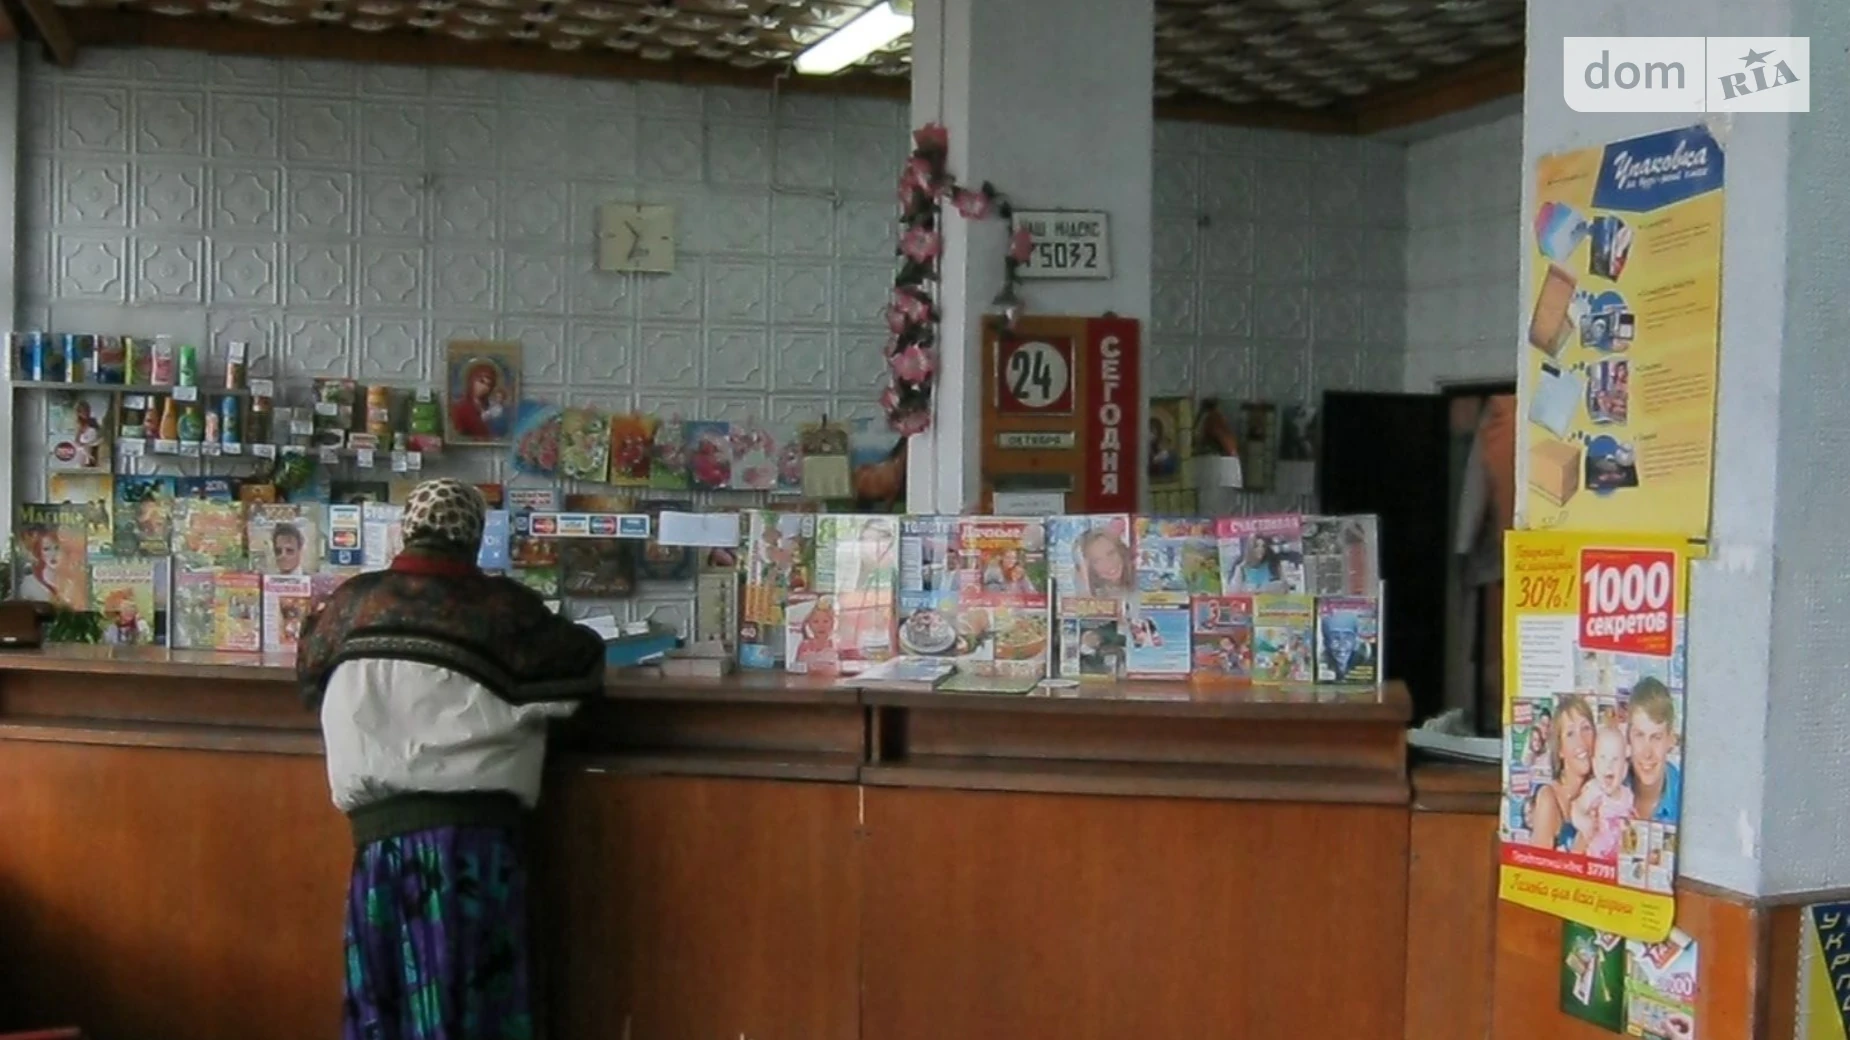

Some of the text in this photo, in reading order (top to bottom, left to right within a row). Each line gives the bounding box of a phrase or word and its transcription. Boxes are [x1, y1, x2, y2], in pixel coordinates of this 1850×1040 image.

[1613, 139, 1708, 190] Упаковка
[1012, 350, 1052, 399] 24
[1099, 335, 1121, 495] СЕГОДНЯ
[1584, 560, 1670, 614] 1000
[1586, 611, 1668, 643] секретов
[1819, 911, 1850, 1012] УКРП
